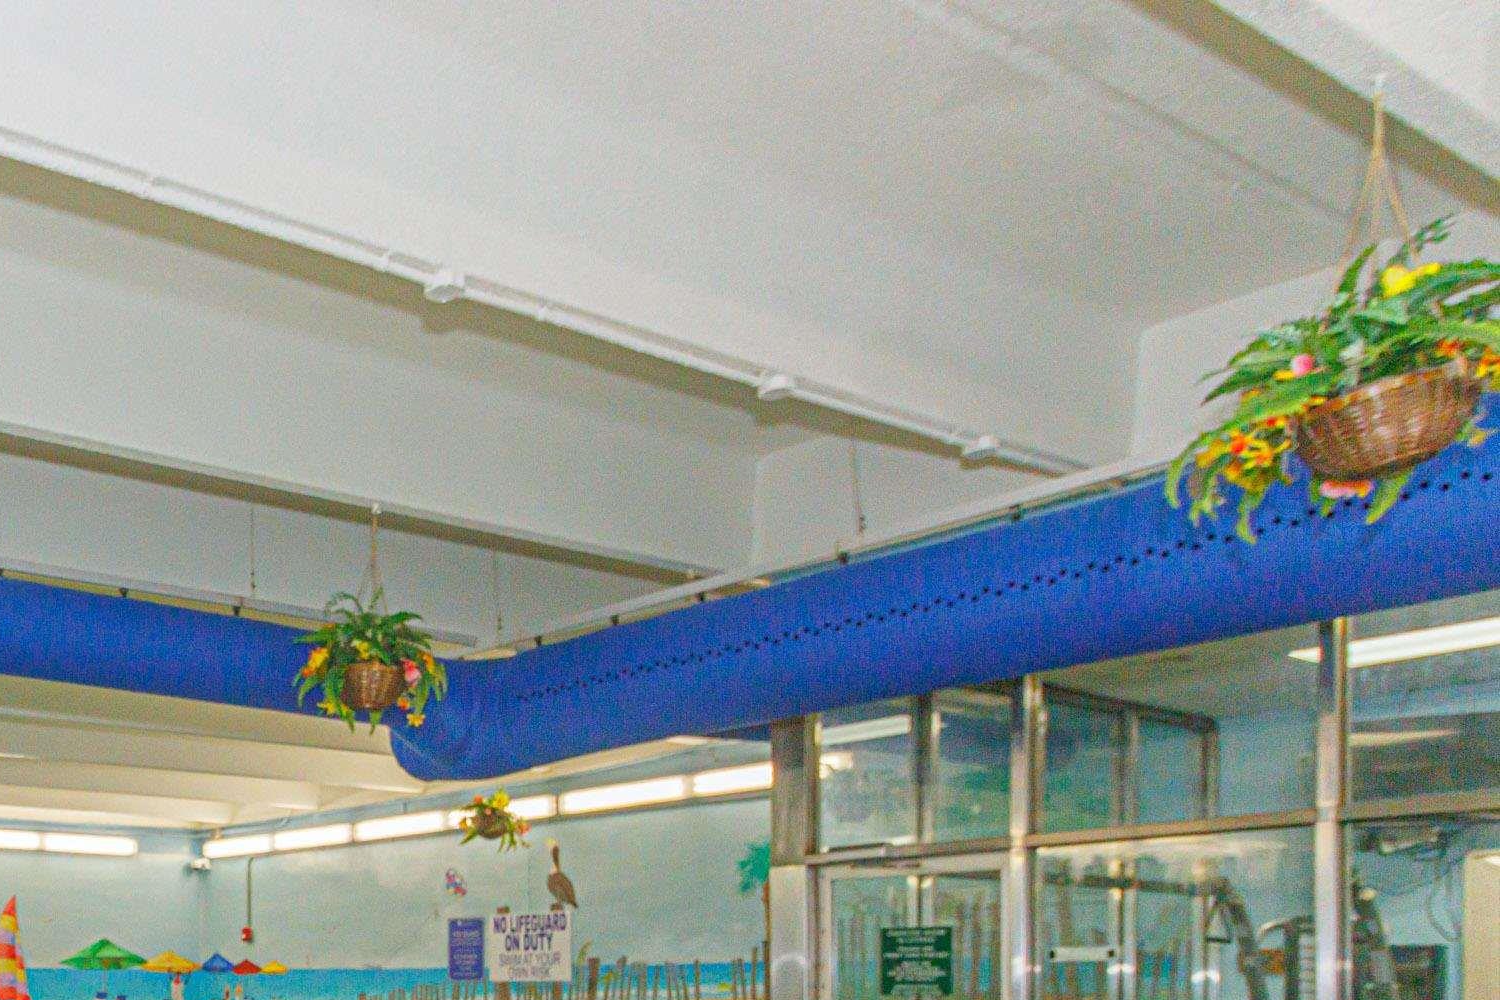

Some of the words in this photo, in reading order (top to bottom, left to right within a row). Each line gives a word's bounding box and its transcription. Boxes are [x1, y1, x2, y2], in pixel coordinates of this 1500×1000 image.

[493, 917, 507, 933] NO
[509, 913, 567, 933] LIFEGUARD
[505, 934, 520, 951] ON
[523, 932, 555, 951] DUTY
